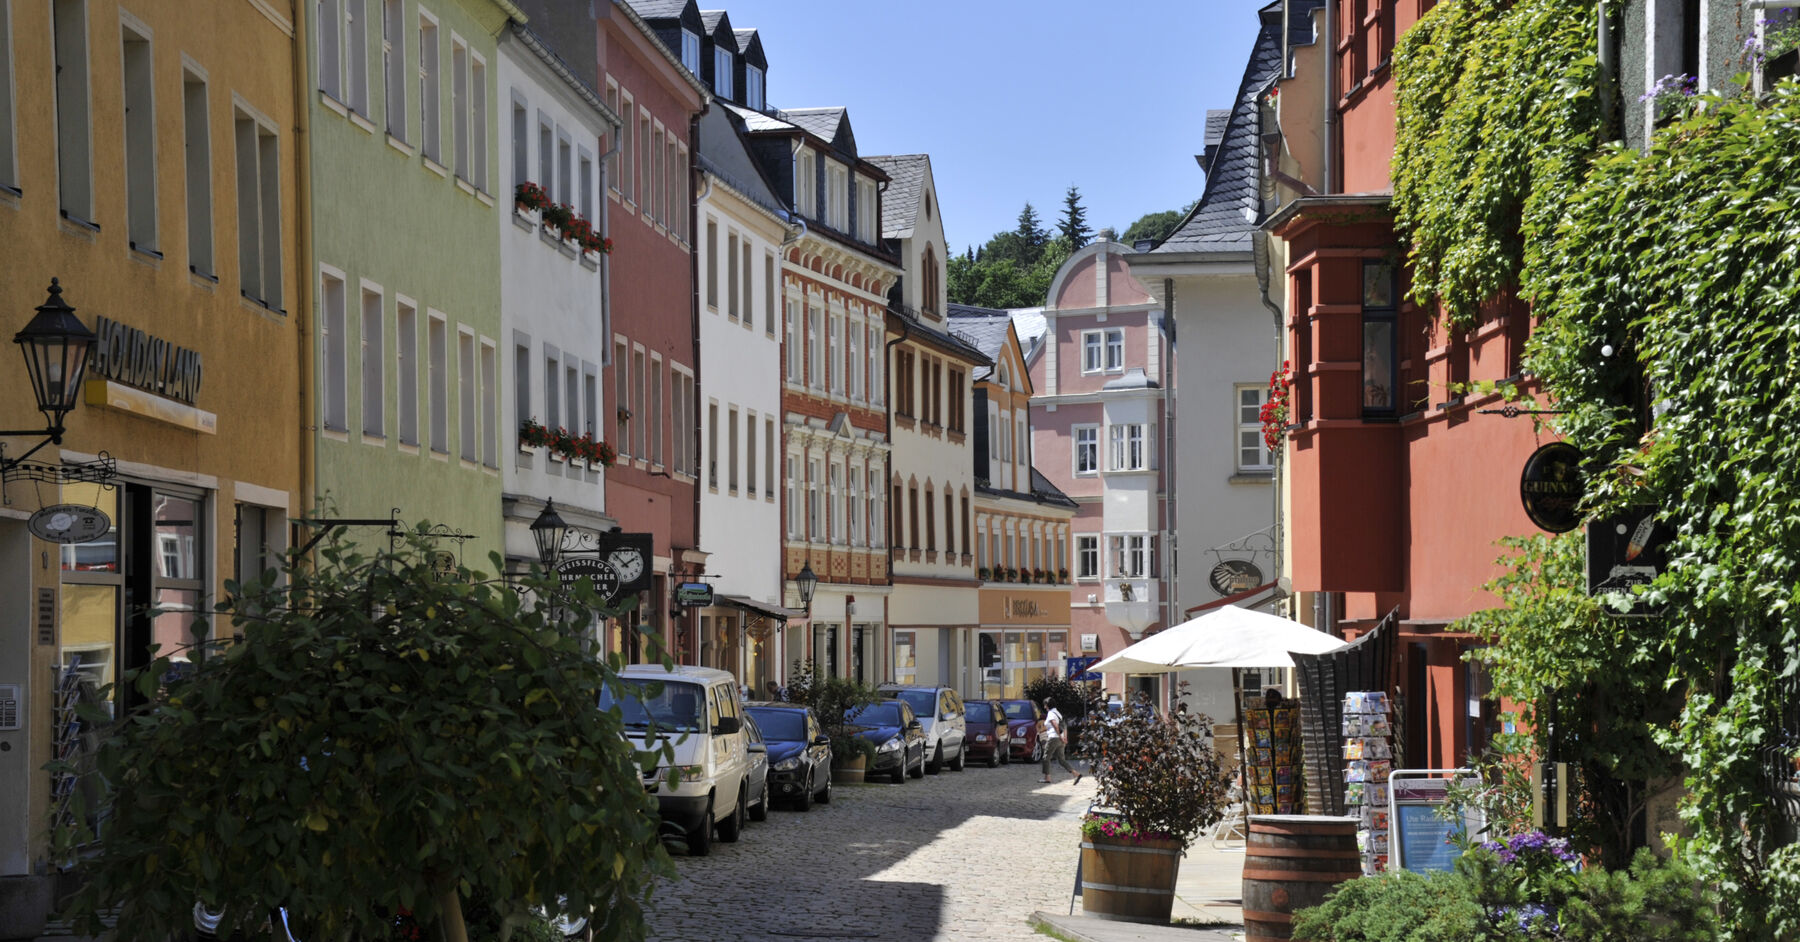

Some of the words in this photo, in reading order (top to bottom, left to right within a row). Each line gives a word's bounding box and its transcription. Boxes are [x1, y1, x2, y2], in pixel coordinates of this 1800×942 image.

[96, 315, 165, 391] HOLIDAY
[164, 342, 203, 405] LAND
[558, 560, 610, 573] WEISSFLOG
[558, 573, 615, 581] HRMCHER
[1625, 579, 1643, 587] ZUR
